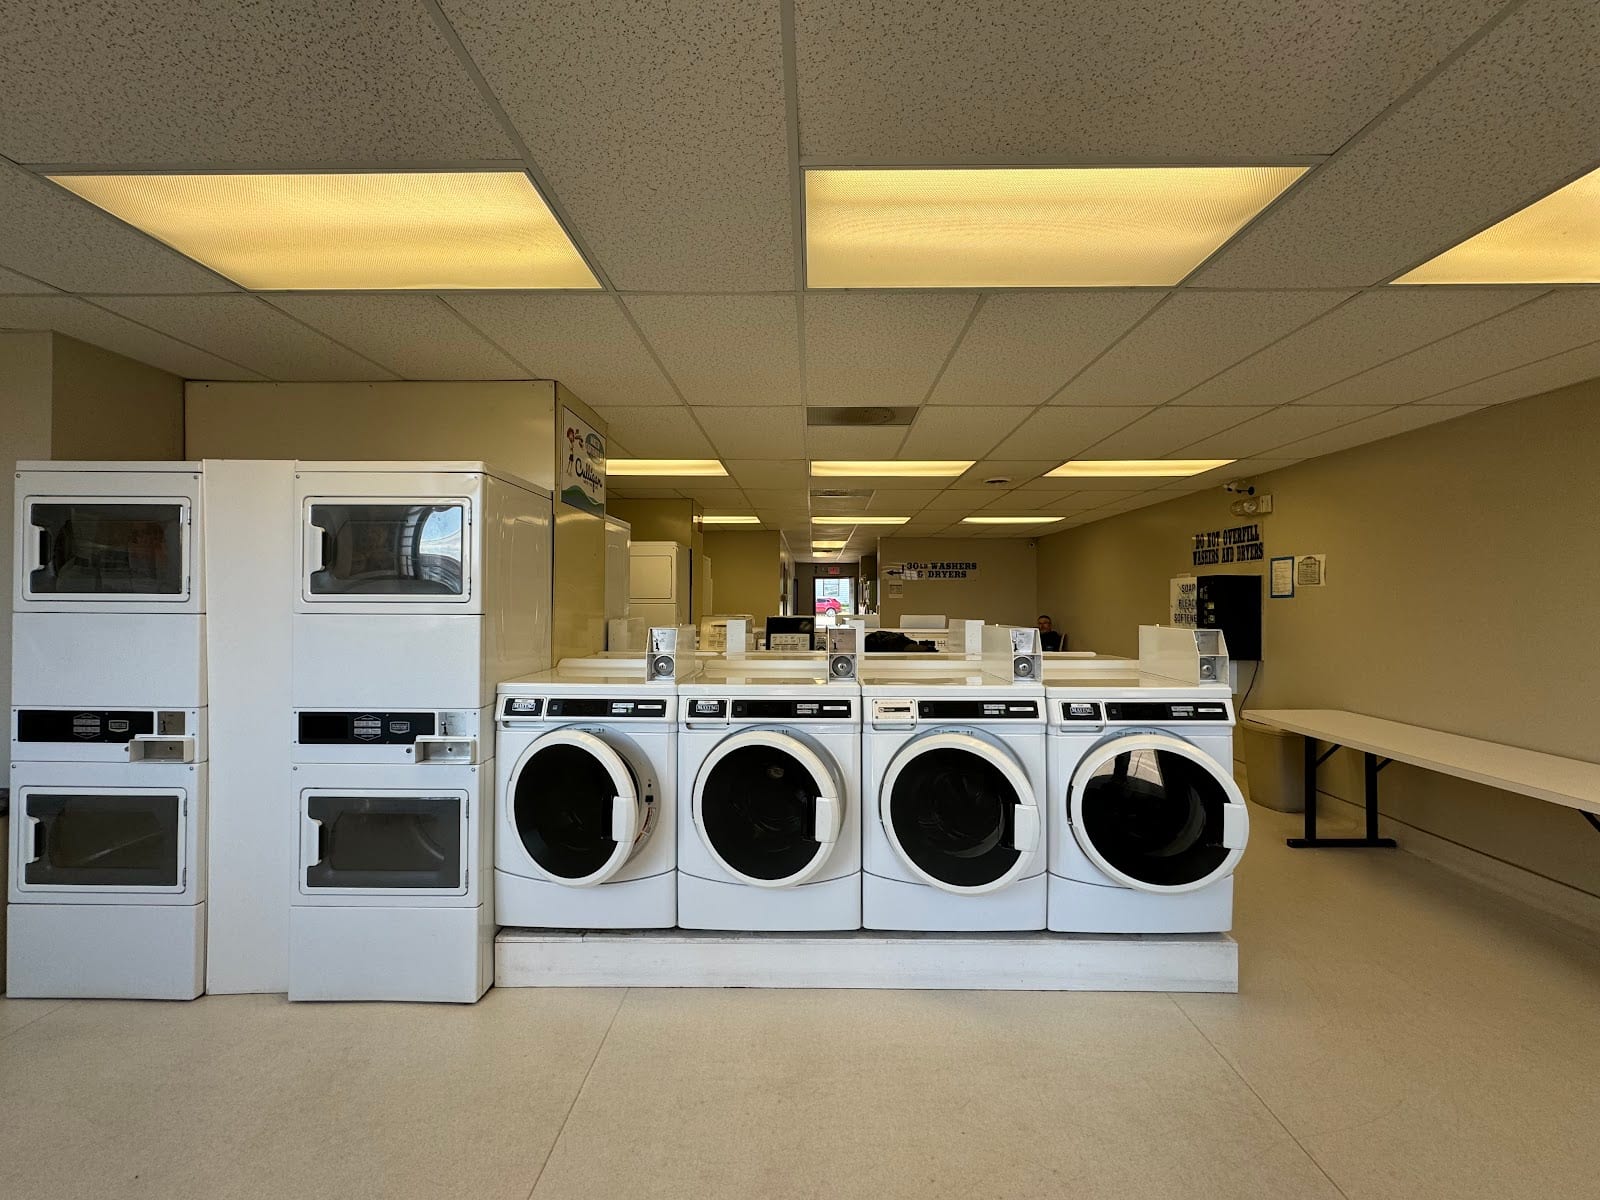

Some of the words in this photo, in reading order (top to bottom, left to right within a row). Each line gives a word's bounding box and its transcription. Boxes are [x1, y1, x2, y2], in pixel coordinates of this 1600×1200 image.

[575, 458, 602, 493] Culligan
[1196, 534, 1204, 549] DO
[1206, 531, 1220, 548] NOT
[1223, 525, 1259, 545] OVERFILL
[1193, 549, 1219, 565] WASHERS
[1222, 547, 1234, 563] AND
[1237, 543, 1263, 561] DRYERS
[931, 562, 977, 570] WASHERS
[1181, 584, 1196, 593] SOAP
[1178, 599, 1197, 609] BLEAC
[1174, 613, 1197, 624] SOFTENE
